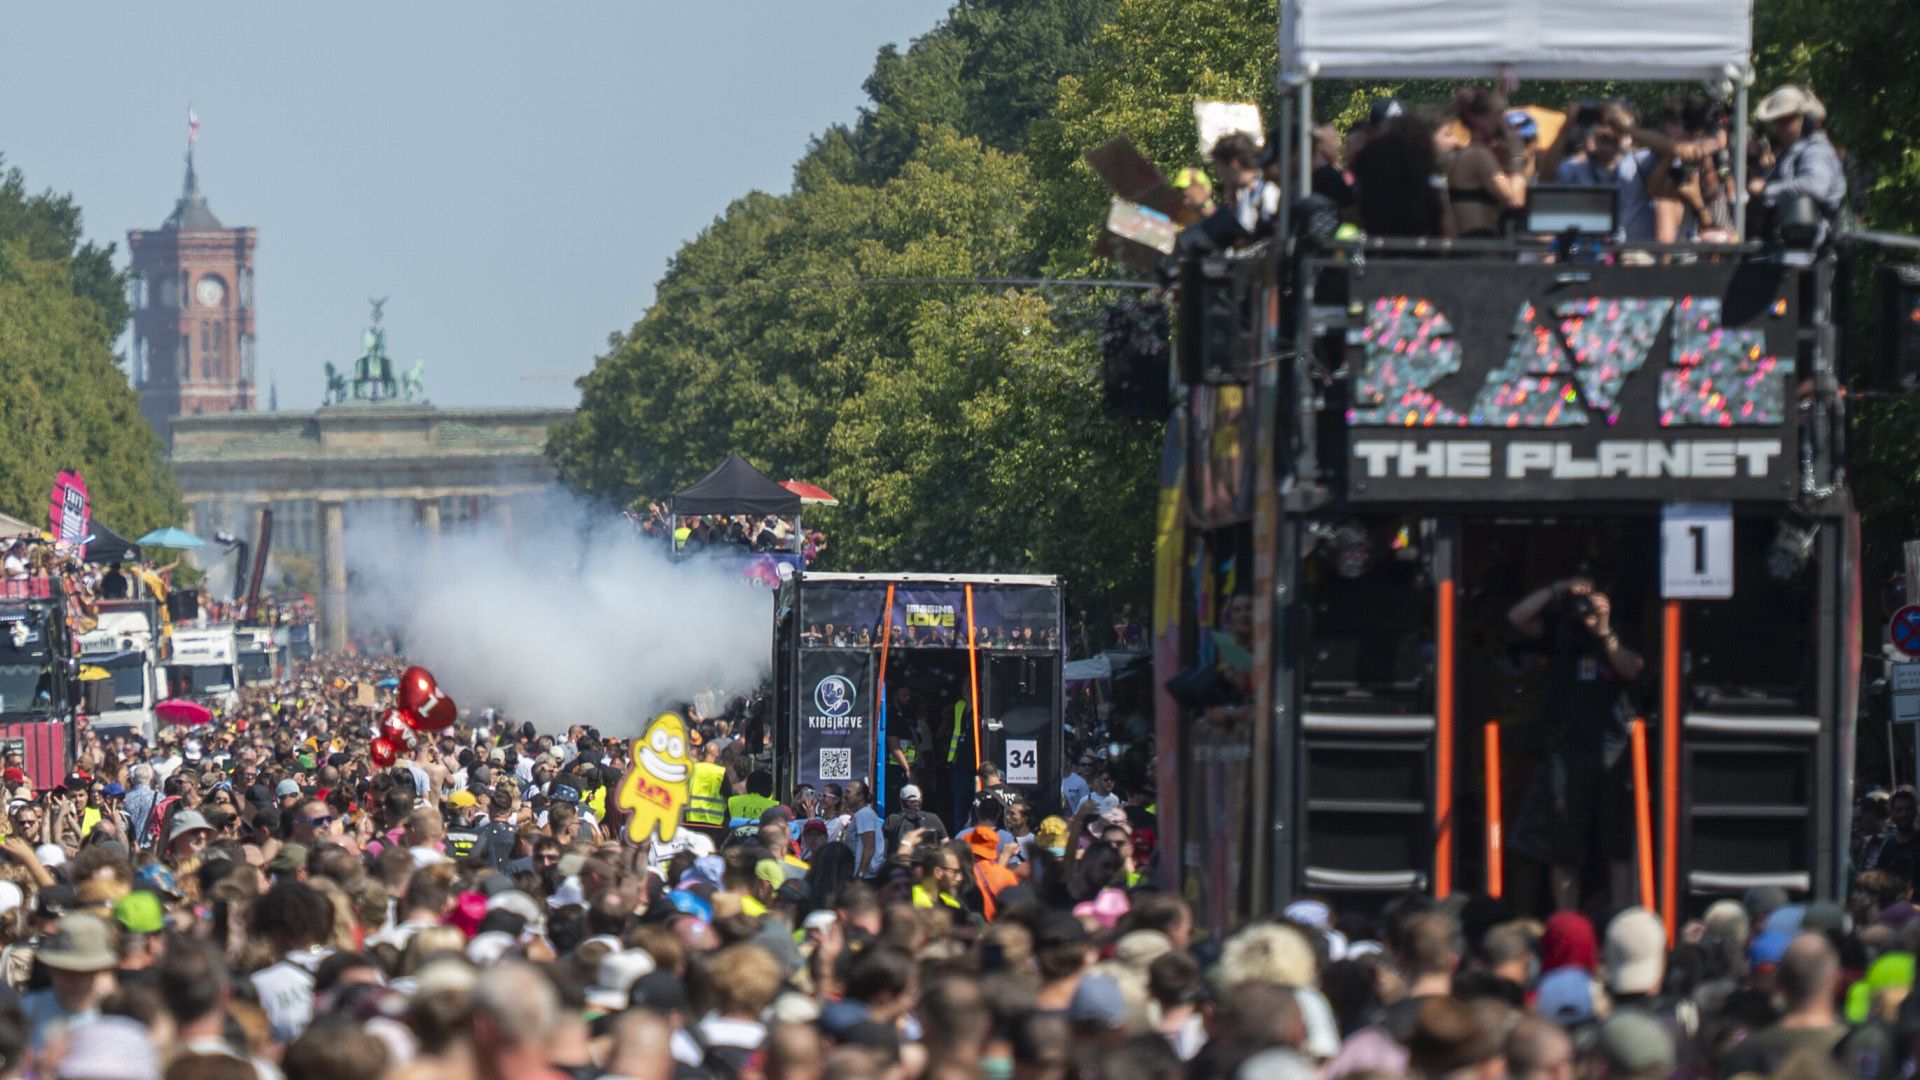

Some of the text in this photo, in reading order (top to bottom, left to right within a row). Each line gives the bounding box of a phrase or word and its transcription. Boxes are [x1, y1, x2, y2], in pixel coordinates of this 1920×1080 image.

[1347, 296, 1795, 427] RAVE
[1353, 439, 1782, 478] THE PLANET
[1687, 525, 1706, 575] 1
[906, 613, 955, 627] LOVE
[1009, 749, 1036, 769] 34
